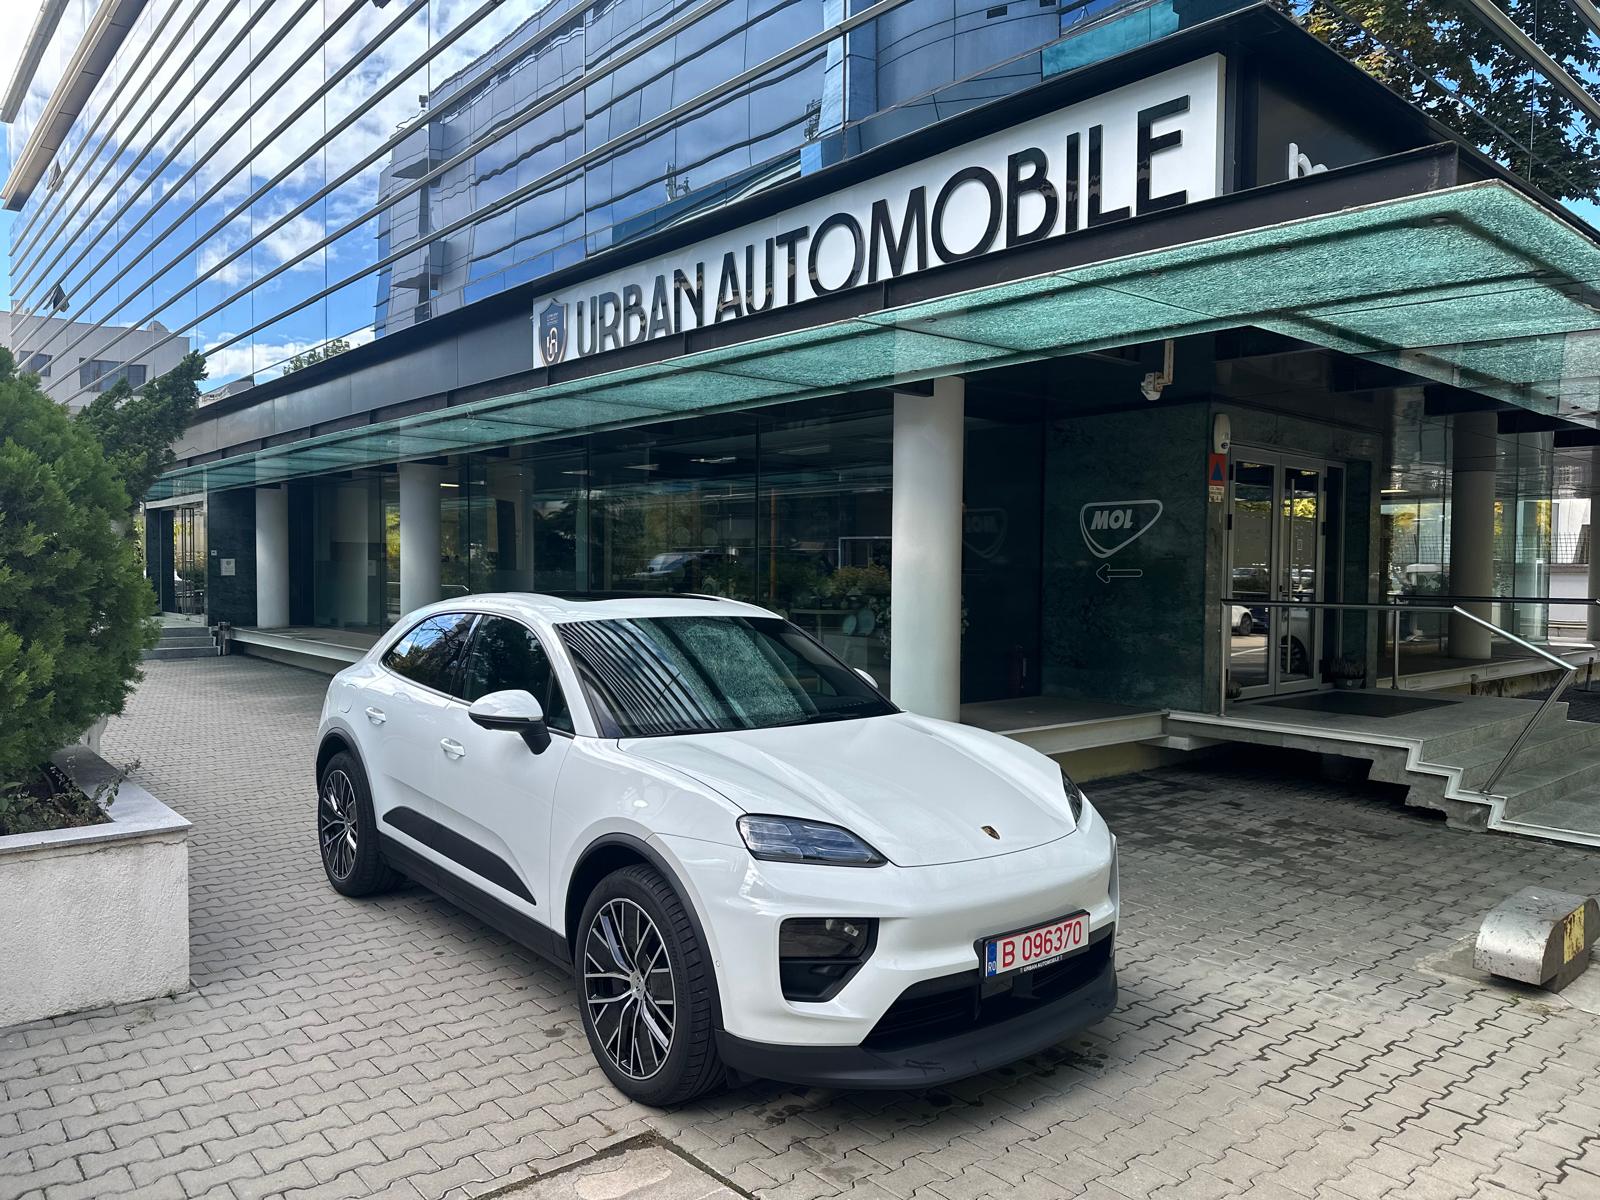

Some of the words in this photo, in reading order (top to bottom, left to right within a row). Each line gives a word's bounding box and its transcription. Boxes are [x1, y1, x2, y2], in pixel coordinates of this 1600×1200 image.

[577, 262, 705, 356] URBAN
[714, 94, 1190, 323] AUTOMOBILE
[1090, 509, 1133, 530] MOL
[1002, 940, 1015, 968] B
[1022, 920, 1082, 961] 096370
[987, 960, 997, 972] RO
